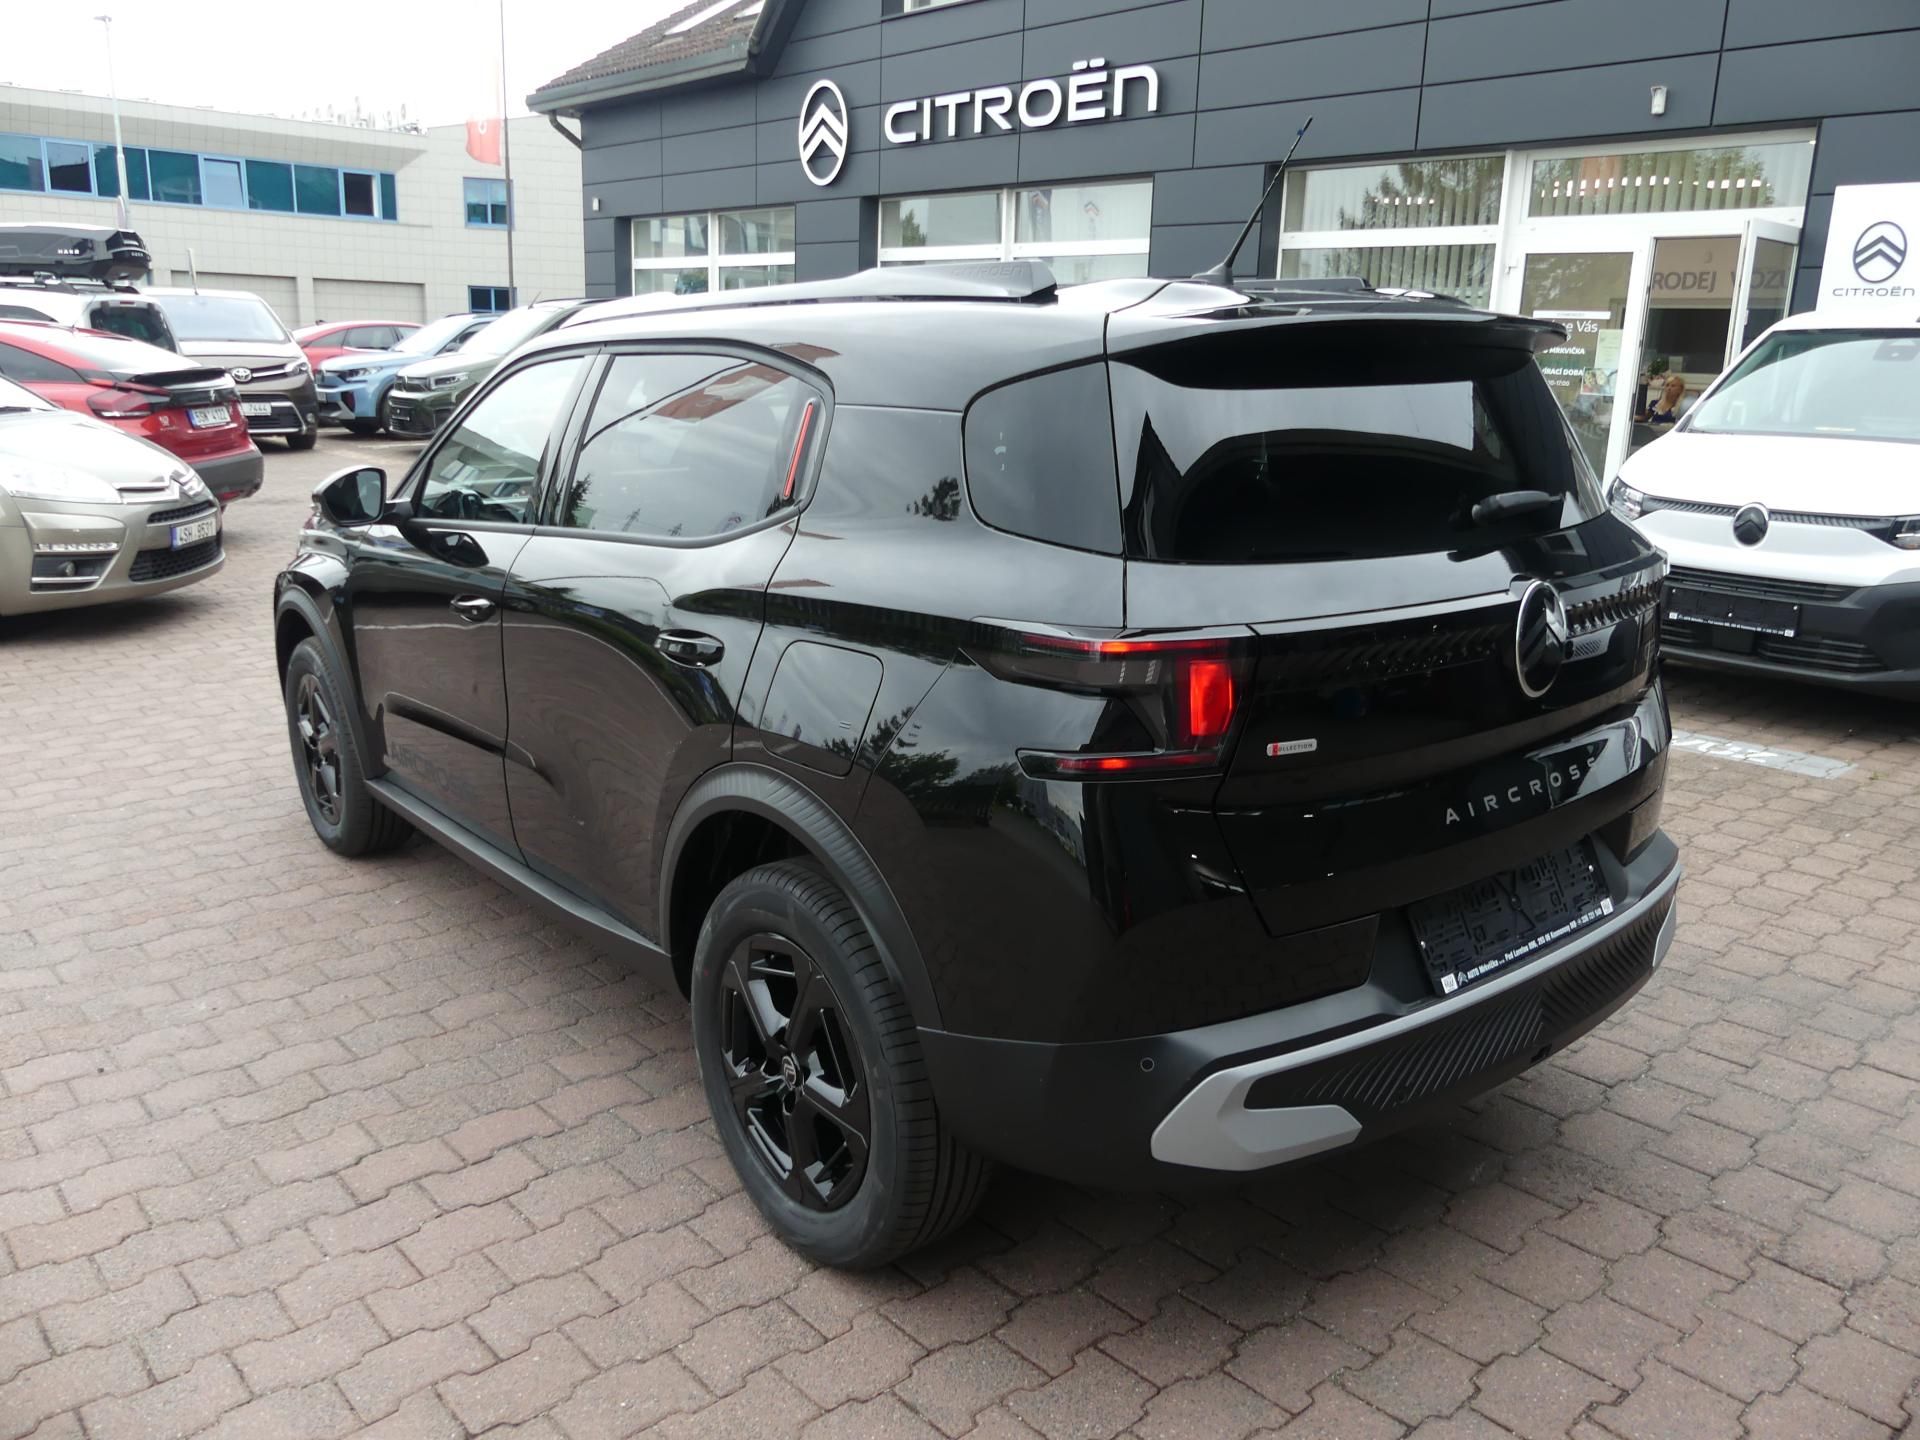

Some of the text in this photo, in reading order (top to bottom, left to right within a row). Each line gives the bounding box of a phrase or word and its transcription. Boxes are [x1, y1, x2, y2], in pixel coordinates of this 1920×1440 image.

[884, 57, 1159, 144] CITROËN
[1651, 270, 1717, 293] RODEJ
[1832, 285, 1915, 297] CITROËN
